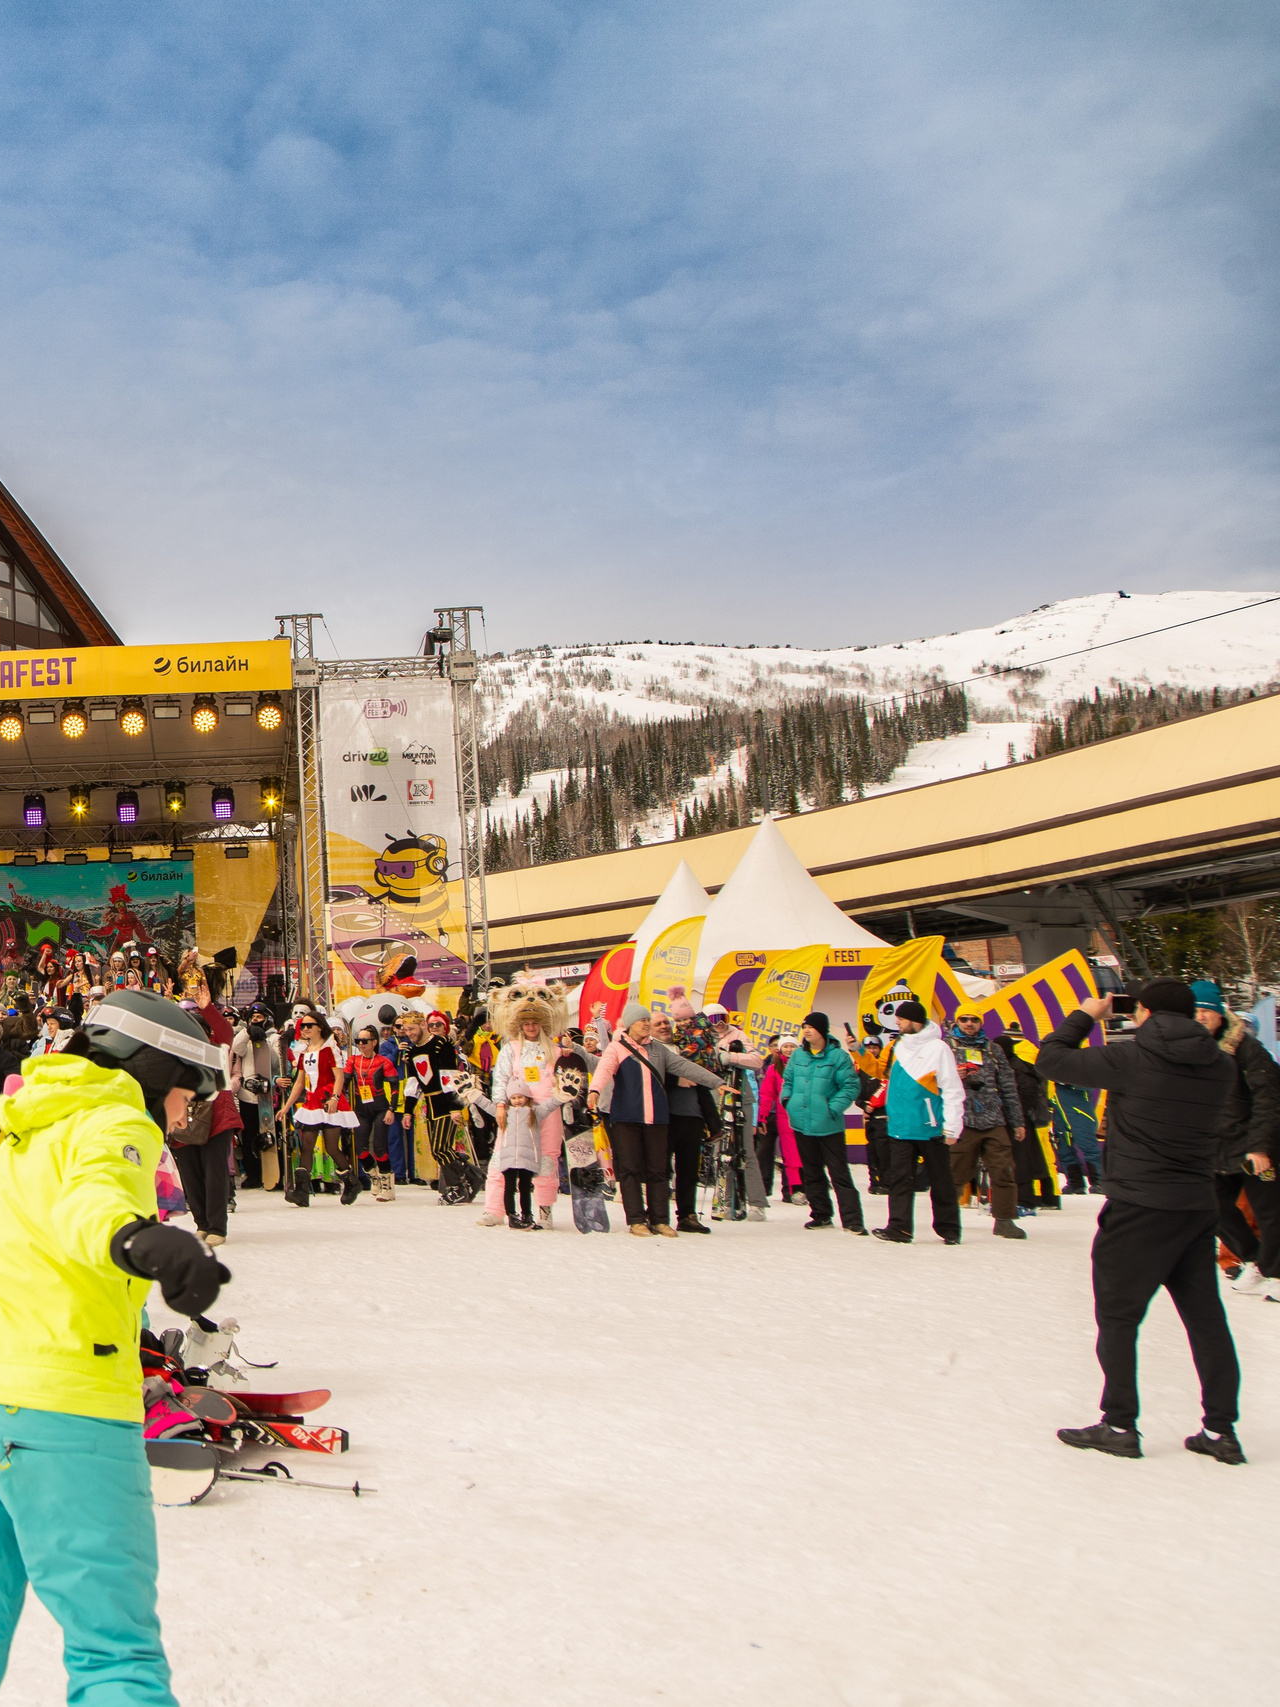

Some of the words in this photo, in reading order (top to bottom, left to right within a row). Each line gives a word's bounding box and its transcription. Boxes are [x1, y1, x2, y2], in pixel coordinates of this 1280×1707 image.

[176, 655, 249, 673] билайн
[402, 752, 436, 760] MOUNTAIN
[141, 870, 183, 881] билайн
[834, 950, 861, 963] FEST
[290, 1427, 312, 1445] 140
